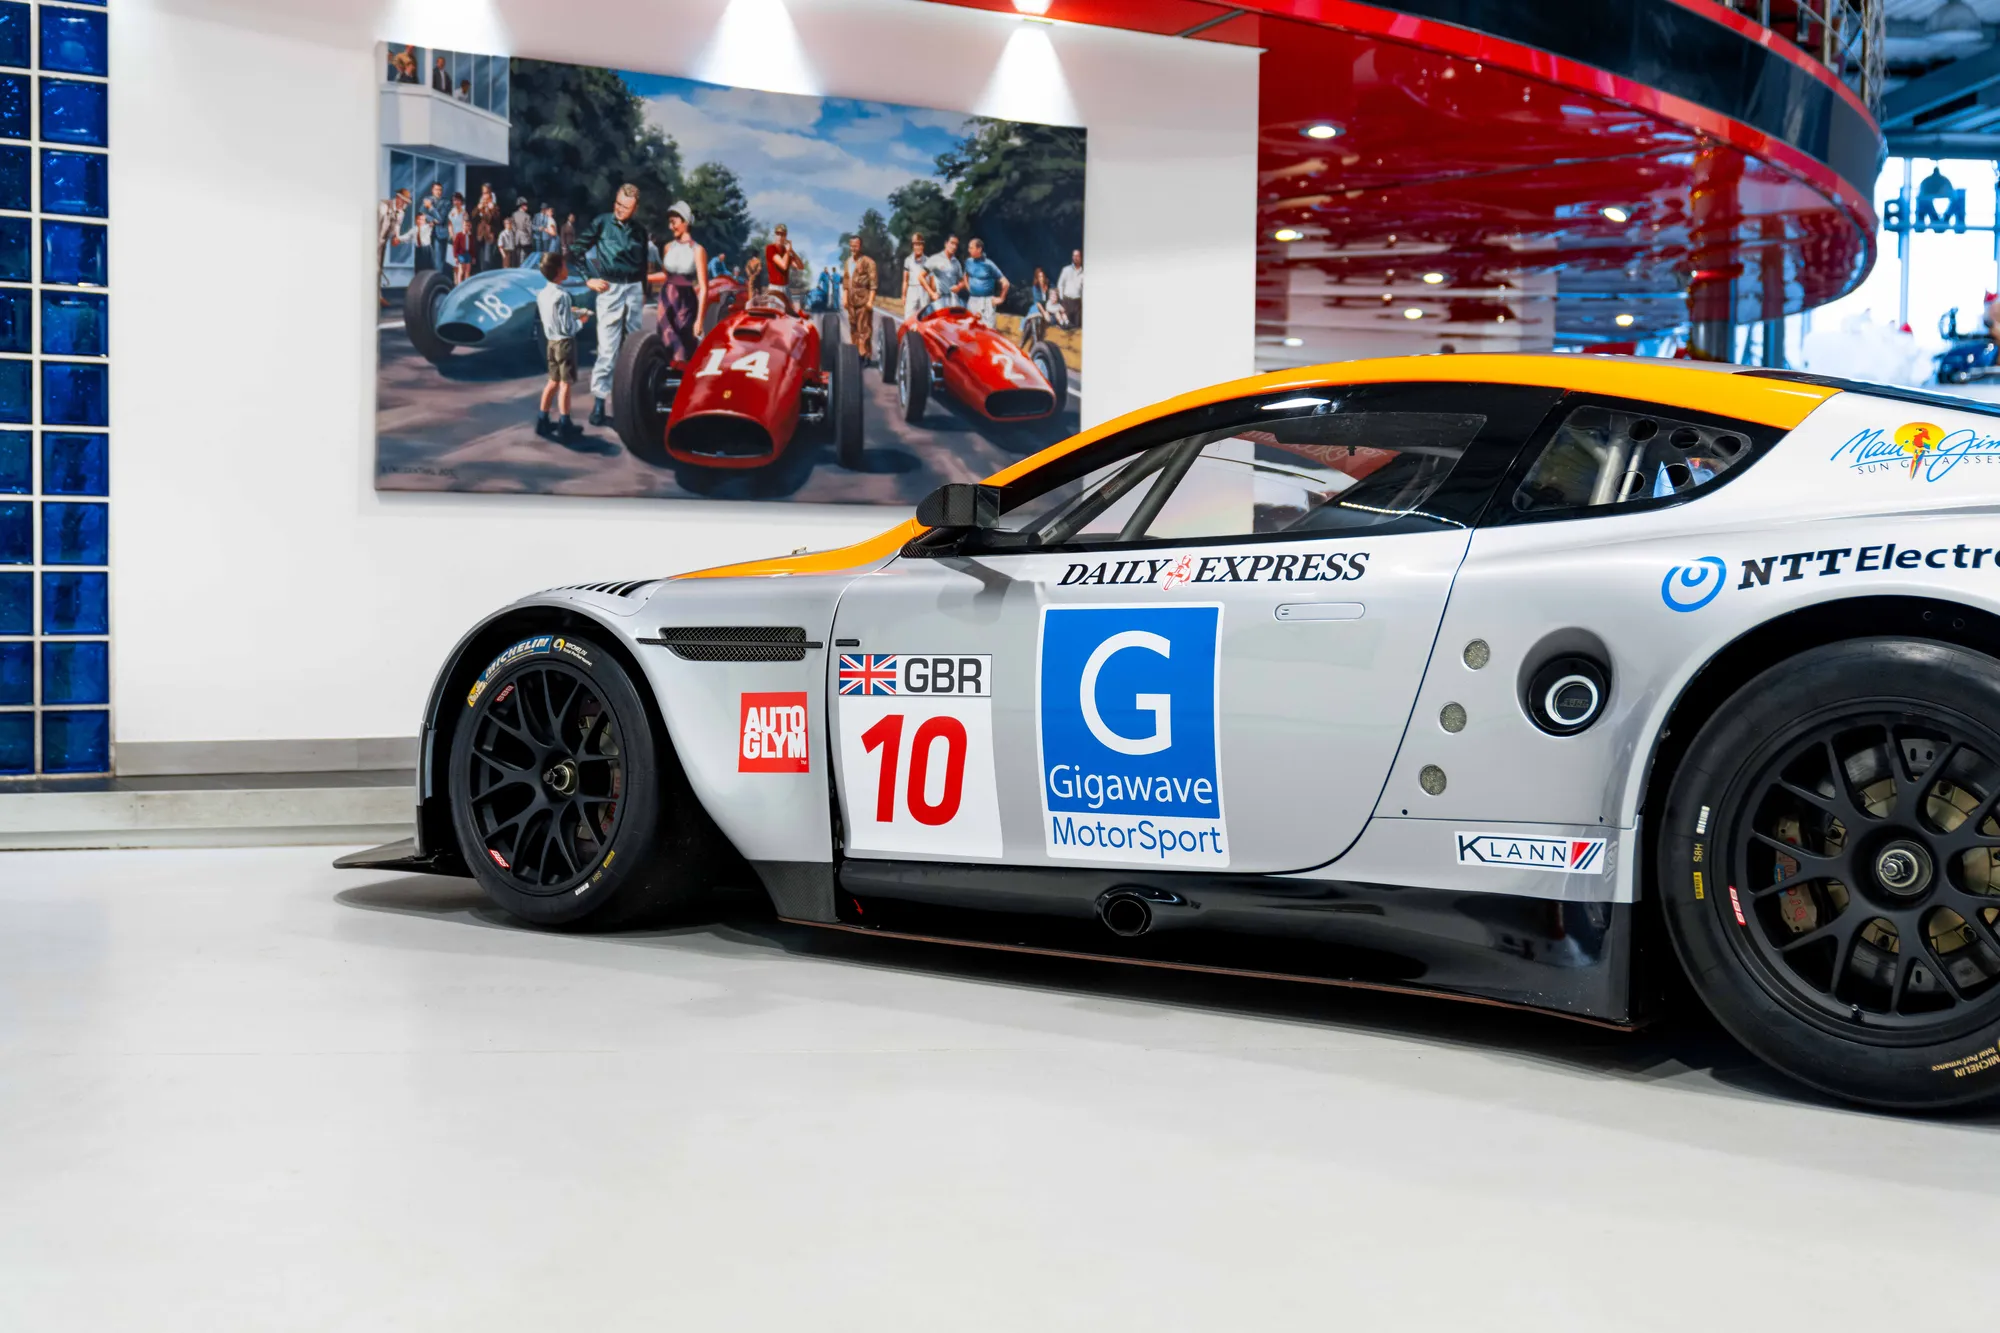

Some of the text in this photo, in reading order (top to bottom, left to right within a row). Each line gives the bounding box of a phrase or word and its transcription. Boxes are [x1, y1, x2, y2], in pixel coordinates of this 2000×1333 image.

[474, 294, 512, 322] 18
[696, 348, 770, 380] 14
[992, 354, 1025, 379] 2
[1831, 428, 1909, 463] Maui
[1057, 552, 1370, 586] DAILY EXPRESS
[1737, 548, 1852, 590] NTT
[485, 637, 550, 679] MICHELIN
[904, 658, 982, 693] GBR
[1079, 630, 1172, 756] G
[744, 705, 805, 733] AUTO
[743, 731, 806, 759] GLYM
[861, 714, 968, 826] 10
[1050, 764, 1213, 809] Gigawave
[1052, 816, 1223, 858] MotorSport
[1458, 835, 1567, 863] KLANN
[1693, 843, 1704, 862] S8H
[1953, 1054, 2000, 1078] MICHELIN
[1978, 1046, 1997, 1060] Total
